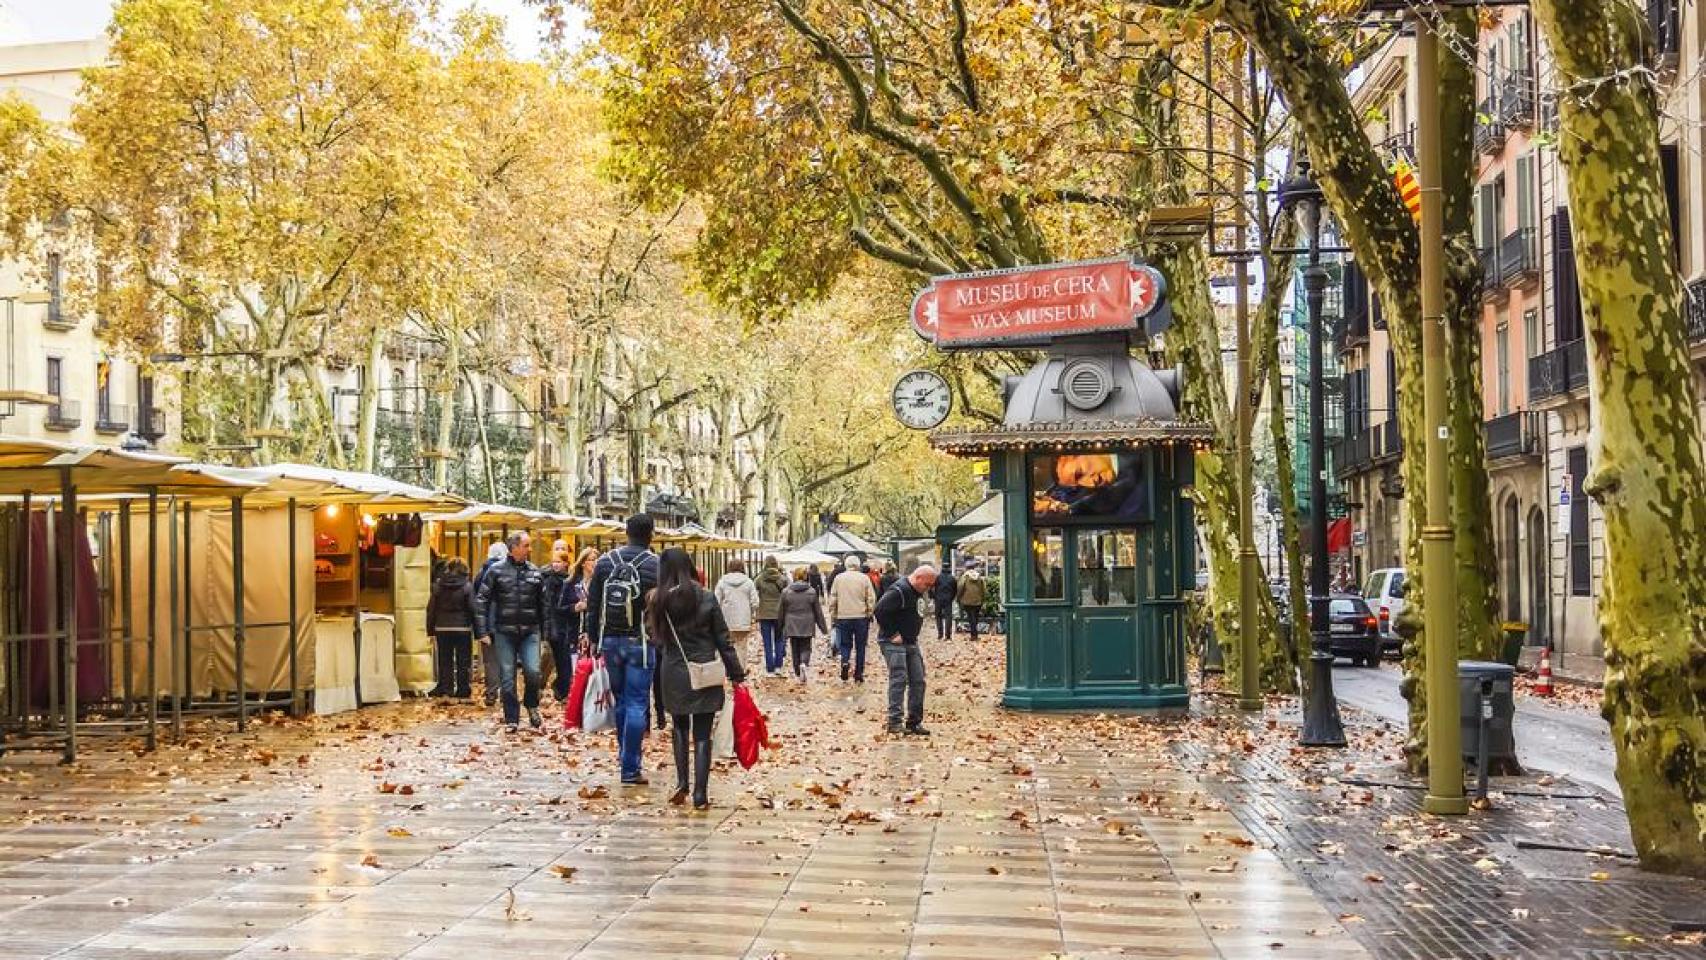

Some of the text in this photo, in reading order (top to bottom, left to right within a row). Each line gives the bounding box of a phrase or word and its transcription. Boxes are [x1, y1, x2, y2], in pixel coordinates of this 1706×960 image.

[956, 273, 1111, 306] MUSEU DE CERA
[970, 303, 1096, 330] WAX MUSEUM
